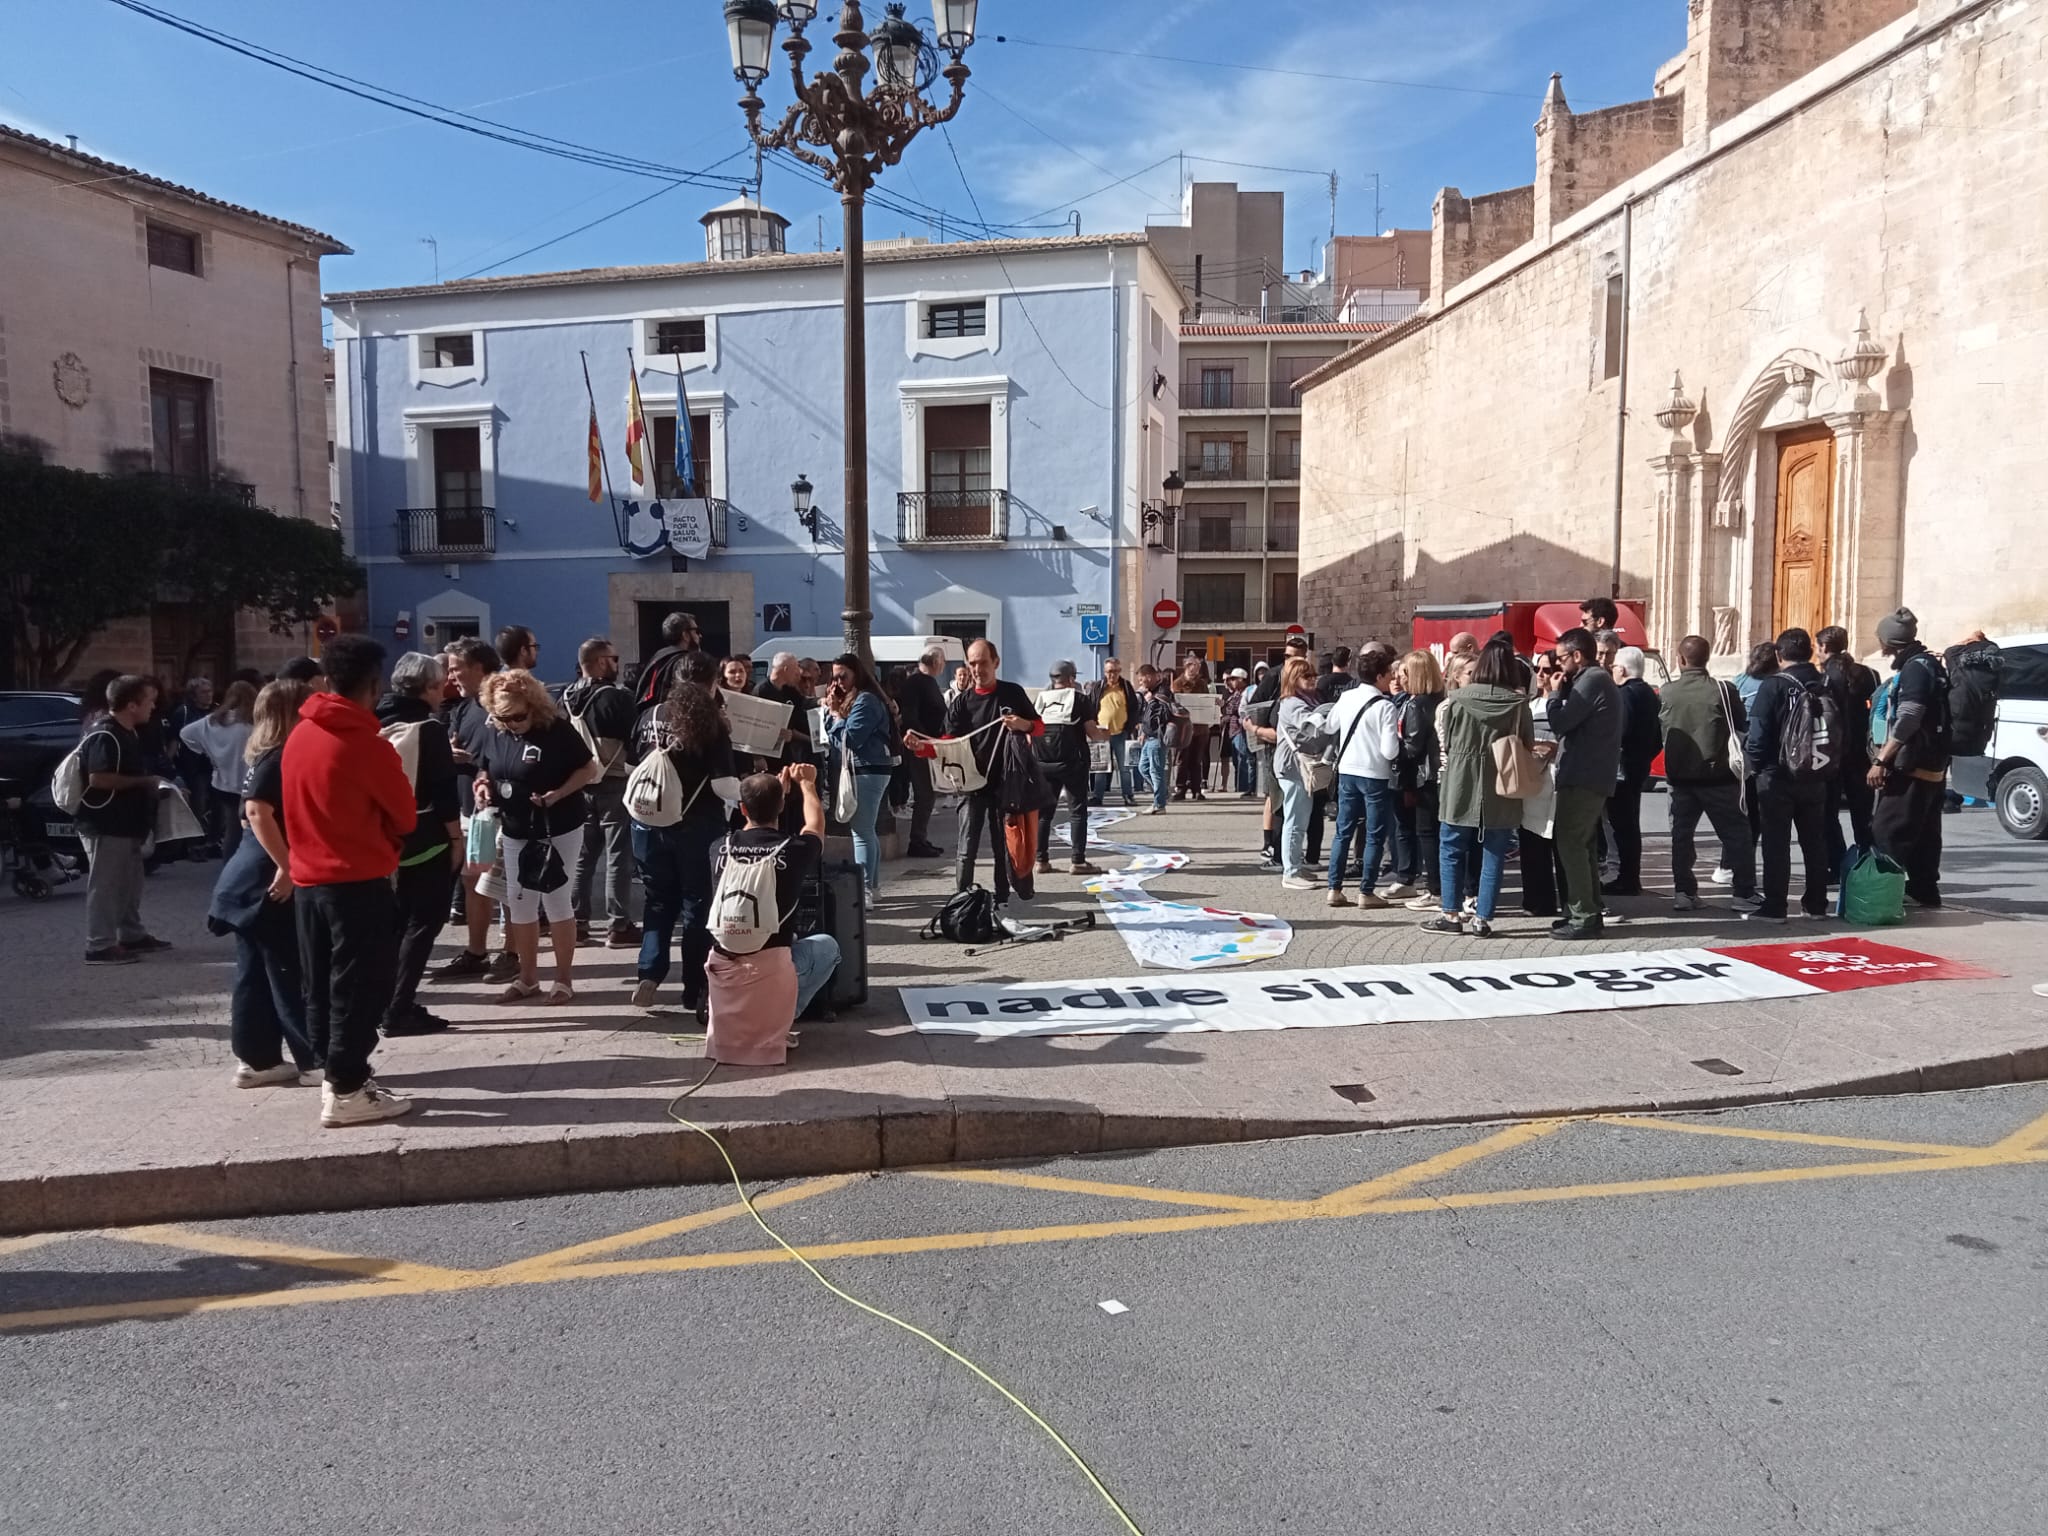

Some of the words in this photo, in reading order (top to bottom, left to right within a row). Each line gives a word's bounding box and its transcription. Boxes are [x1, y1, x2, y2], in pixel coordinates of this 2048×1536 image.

[723, 915, 748, 923] NADIE
[723, 928, 752, 936] HOGAR
[925, 986, 1229, 1017] nadie
[1260, 977, 1414, 1002] sin
[1428, 960, 1733, 993] hogar
